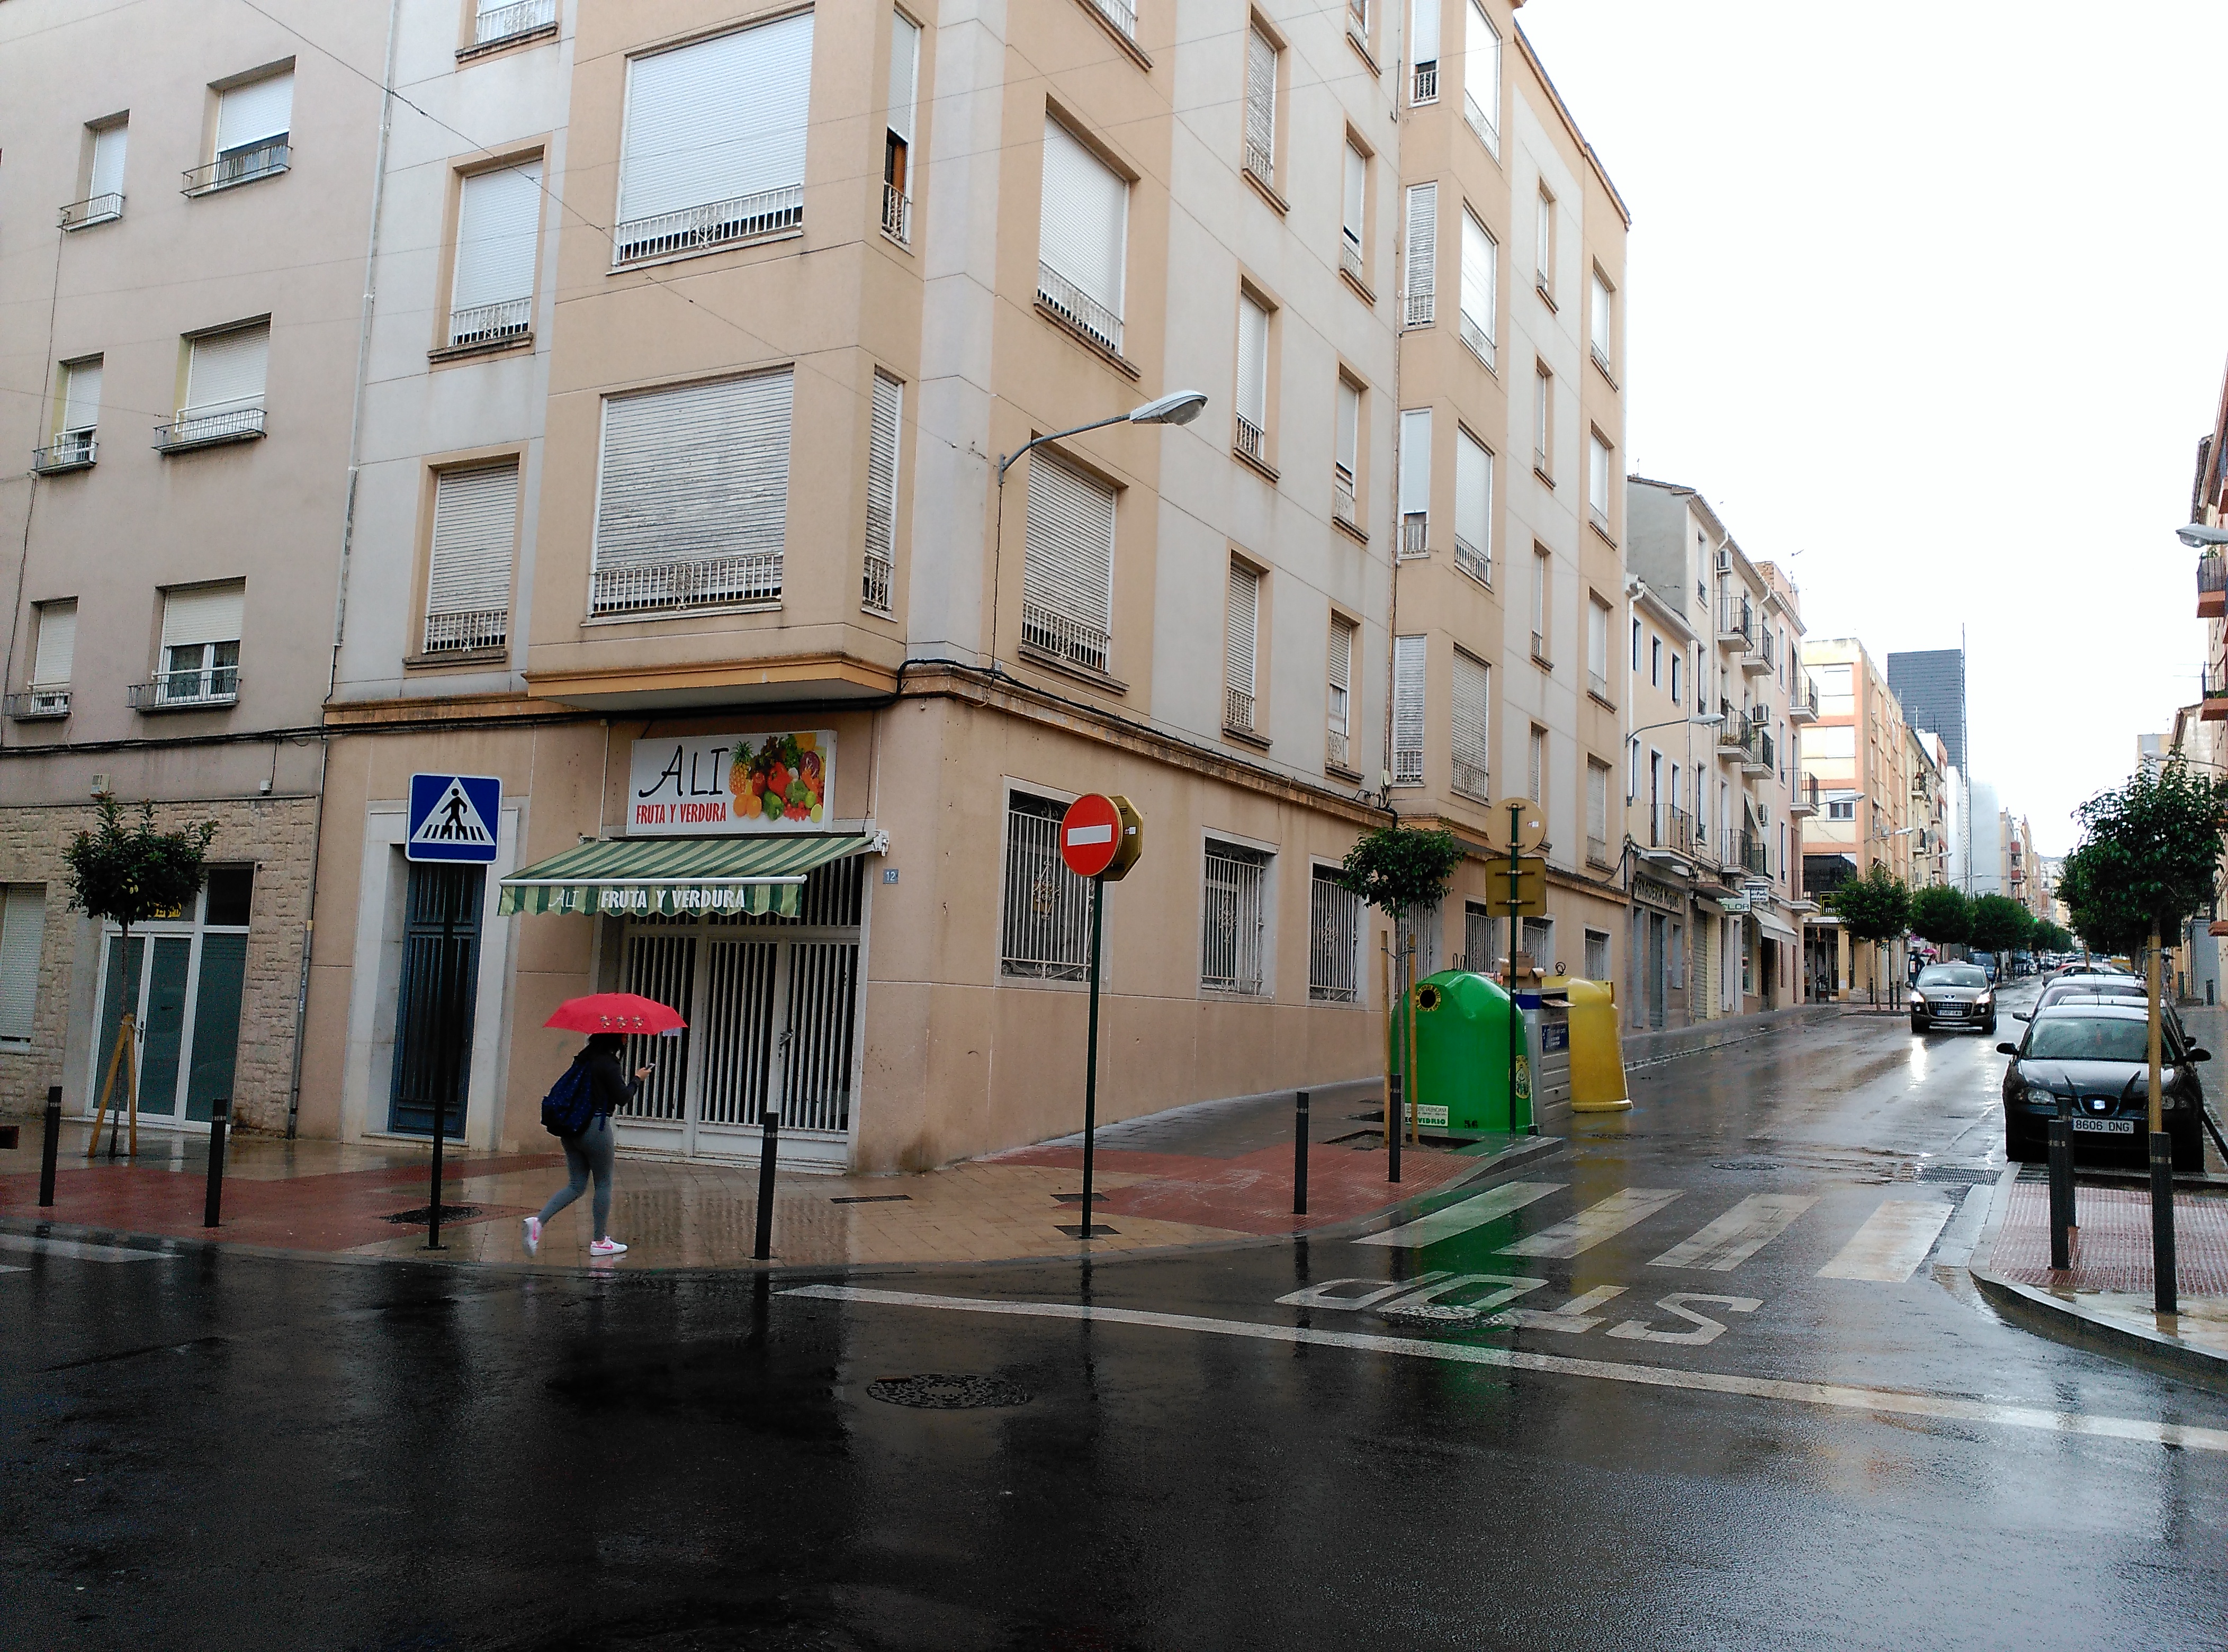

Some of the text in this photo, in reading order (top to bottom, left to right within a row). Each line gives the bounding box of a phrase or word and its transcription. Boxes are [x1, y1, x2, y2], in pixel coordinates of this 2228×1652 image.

[638, 744, 730, 798] ALI
[636, 802, 727, 824] FRUTA Y VERDURA
[886, 871, 895, 881] 12
[549, 889, 745, 908] ALI FRUTA Y VERDURA
[2076, 1120, 2130, 1132] 8606 DNG
[1274, 1271, 1764, 1345] STOP
